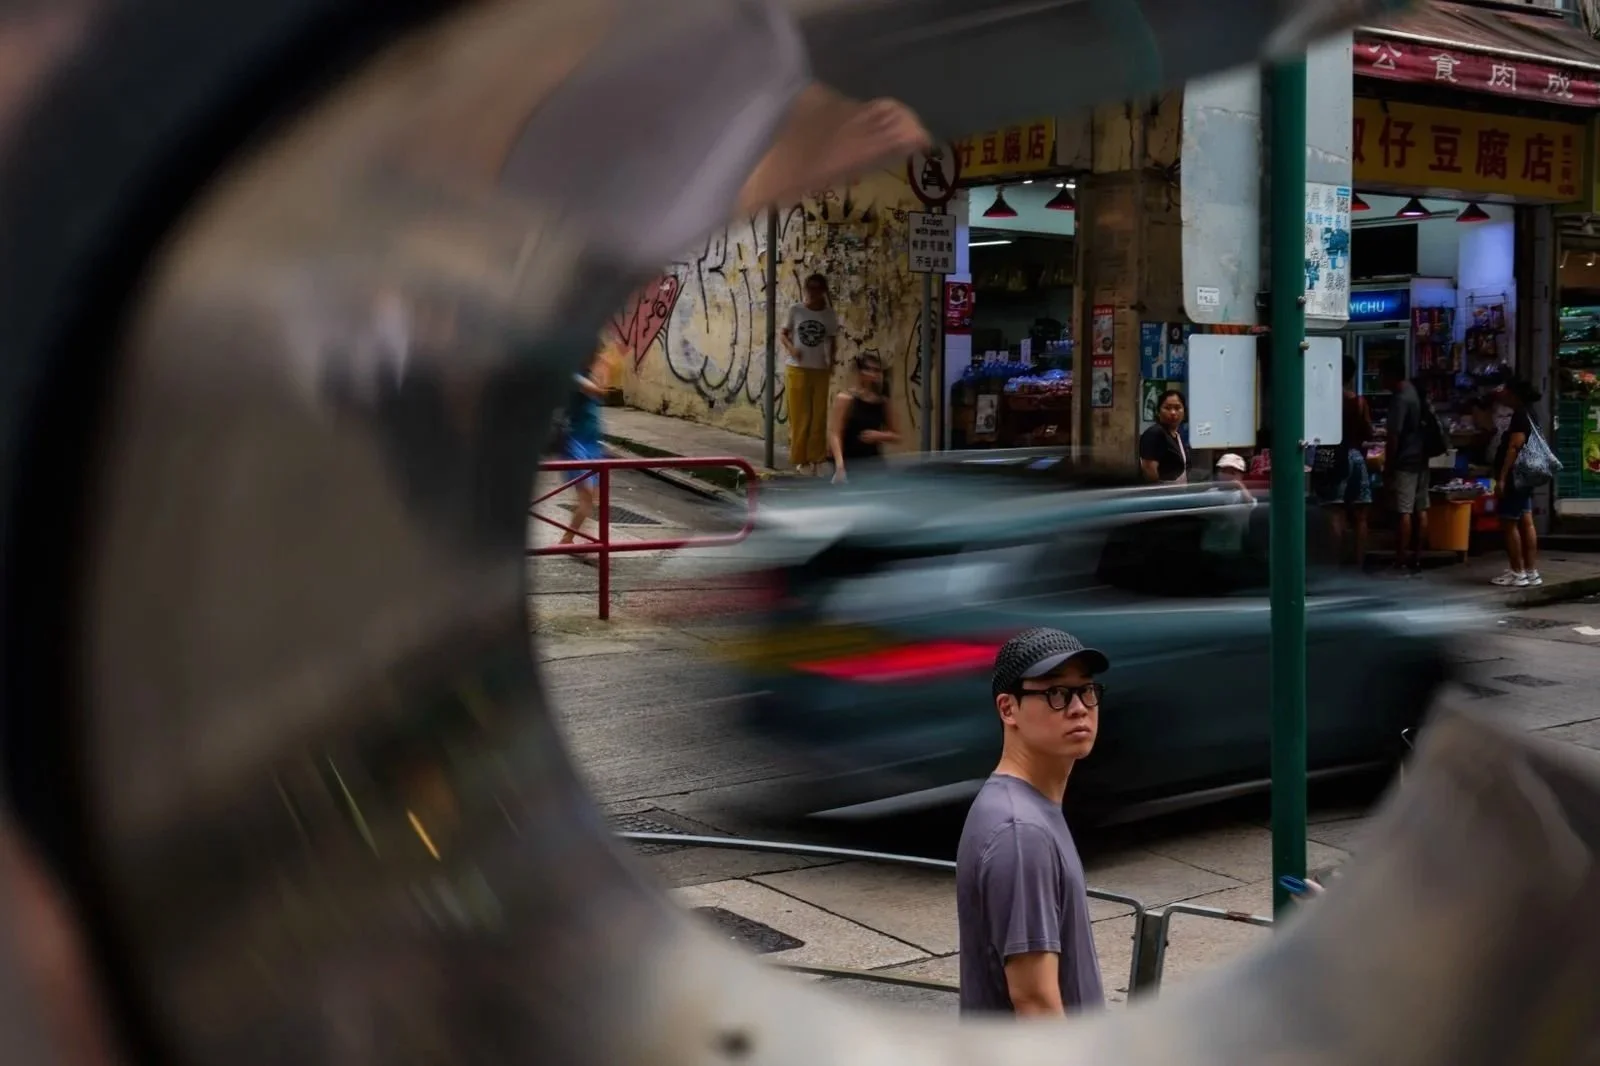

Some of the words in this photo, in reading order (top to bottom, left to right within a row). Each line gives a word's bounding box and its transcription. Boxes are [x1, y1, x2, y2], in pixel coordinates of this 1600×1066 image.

[922, 216, 943, 226] Except
[915, 226, 928, 235] with
[930, 228, 949, 237] permit
